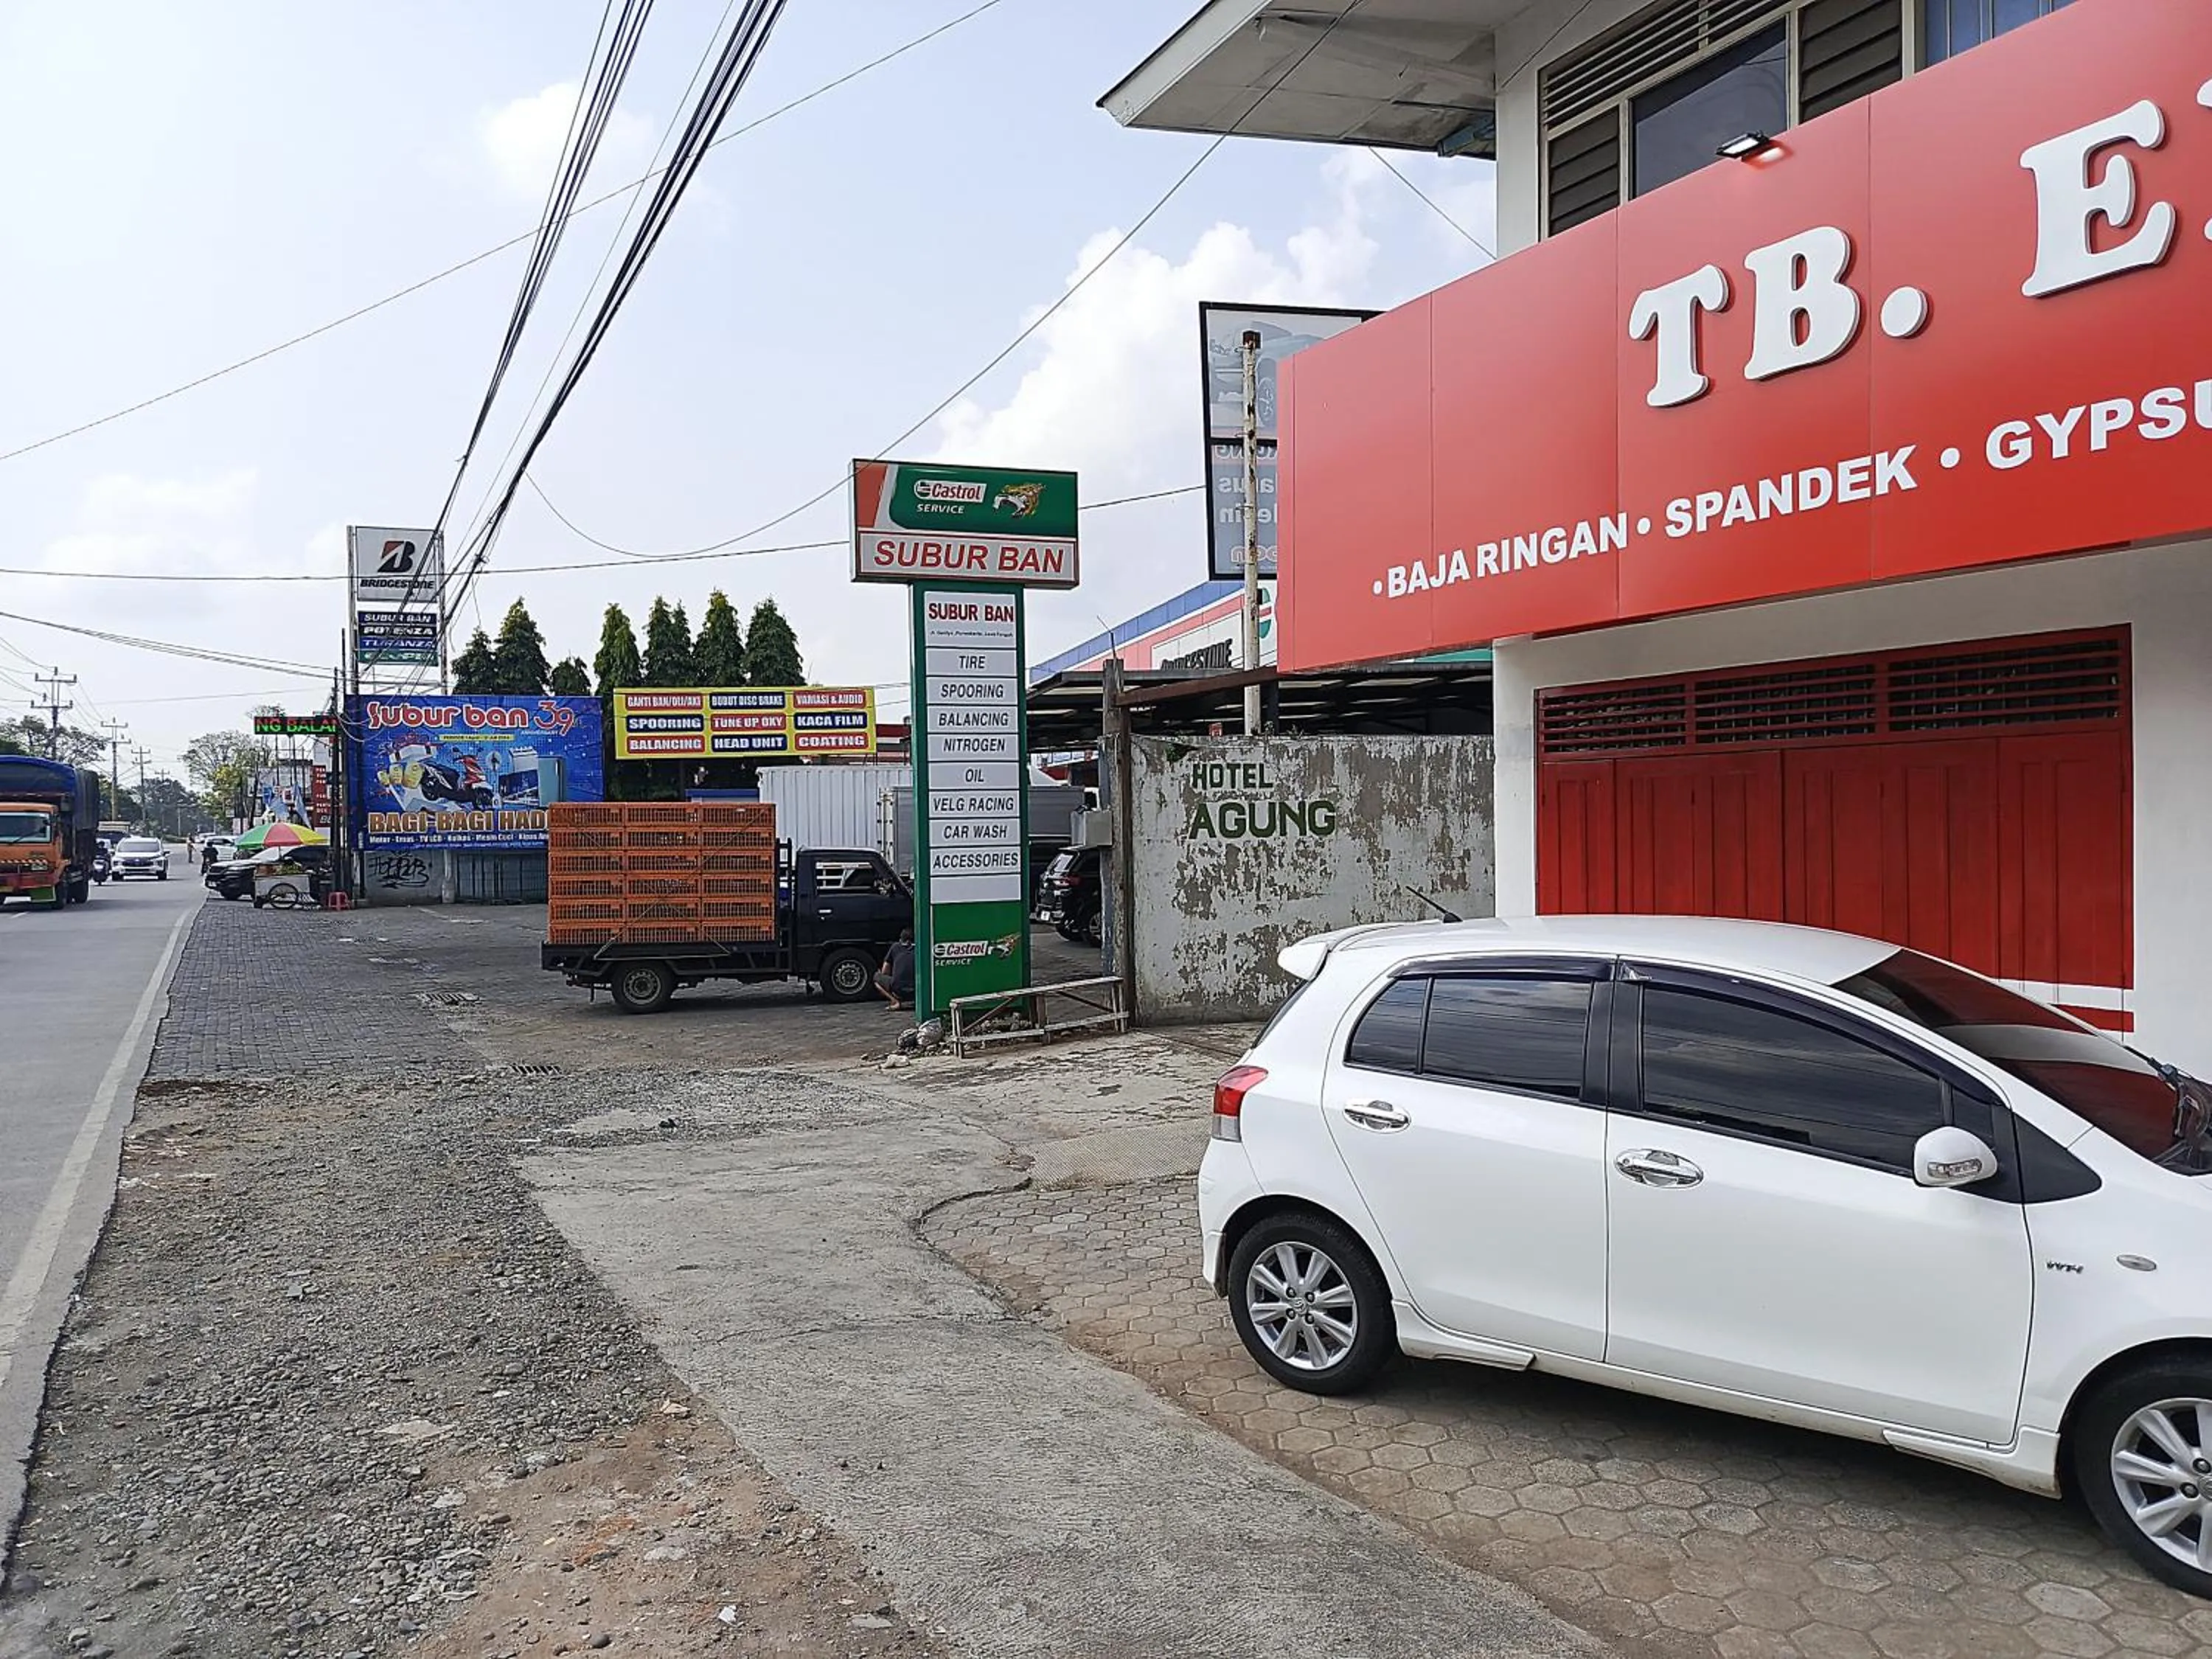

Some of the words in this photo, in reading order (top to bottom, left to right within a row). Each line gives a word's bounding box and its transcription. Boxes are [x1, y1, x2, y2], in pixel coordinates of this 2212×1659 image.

[1629, 225, 1933, 408] TB.
[2019, 80, 2212, 298] E
[931, 483, 981, 500] Castrol
[917, 504, 965, 514] SERVICE
[1387, 549, 1470, 599] BAJA
[1477, 512, 1628, 578] RINGAN
[1665, 445, 1918, 539] SPANDEK
[874, 540, 988, 571] SUBUR
[998, 546, 1064, 573] BAN
[928, 602, 978, 621] SUBUR
[984, 605, 1014, 622] BAN
[959, 655, 986, 669] TIRE
[940, 684, 1004, 698] SPOORING
[627, 696, 651, 706] GANTI
[739, 695, 757, 706] DISC
[759, 695, 784, 706] BRAKE
[838, 694, 863, 703] AUDIO
[463, 704, 529, 728] ban
[533, 700, 575, 736] 39
[629, 717, 701, 729] SPOORING
[713, 718, 742, 728] TUNE
[744, 717, 759, 728] UP
[797, 716, 833, 726] KACA
[835, 715, 863, 726] FILM
[939, 713, 1009, 726] BALANCING
[630, 739, 701, 750] BALANCING
[714, 738, 749, 748] HEAD
[751, 737, 784, 748] UNIT
[799, 736, 865, 747] COATING
[943, 738, 1005, 752] NITROGEN
[964, 768, 984, 782] OIL
[1192, 762, 1273, 791] HOTEL
[933, 797, 965, 811] VELG
[968, 797, 1015, 812] RACING
[1189, 800, 1336, 840] AGUNG
[944, 825, 970, 839] CAR
[973, 824, 1008, 838] WASH
[933, 852, 1018, 869] ACCESSORIES
[946, 943, 985, 956] Castrol
[934, 958, 973, 967] SERVICE
